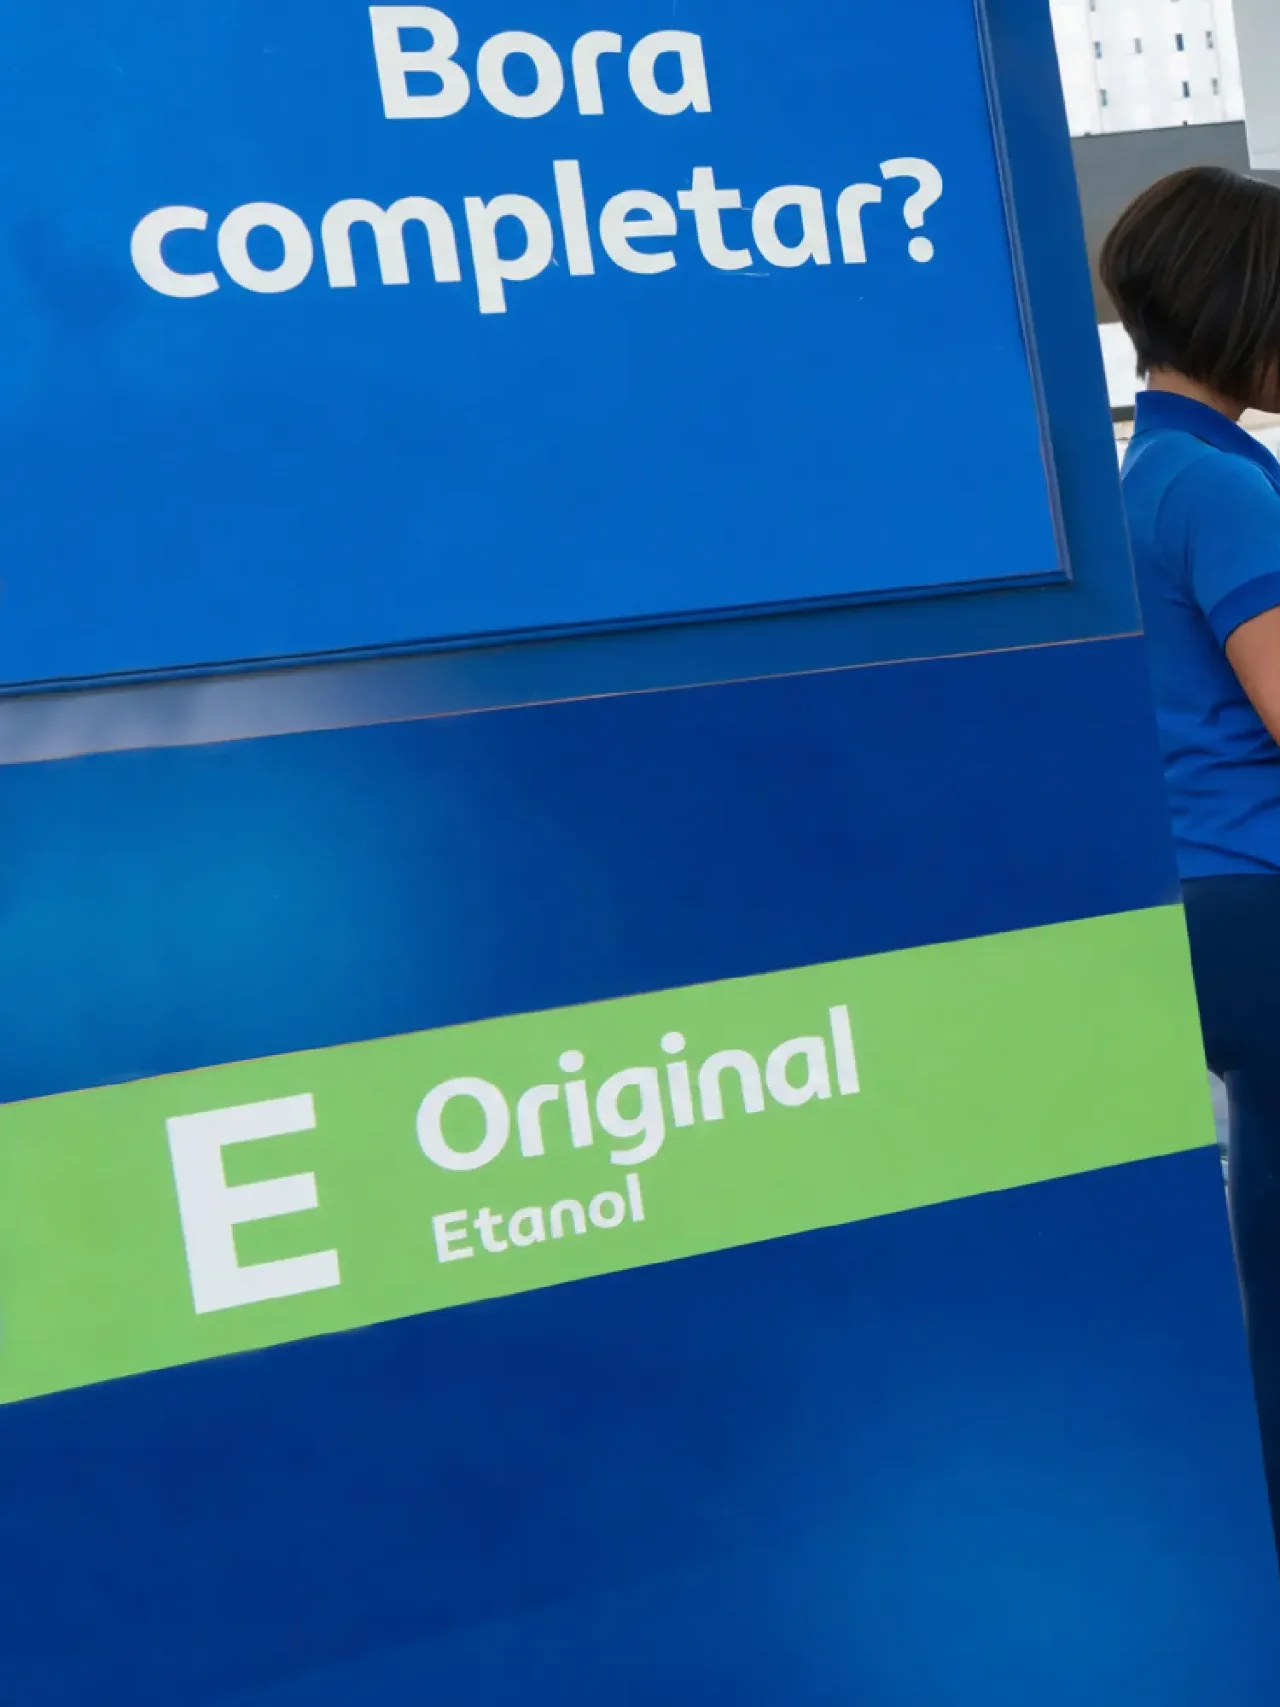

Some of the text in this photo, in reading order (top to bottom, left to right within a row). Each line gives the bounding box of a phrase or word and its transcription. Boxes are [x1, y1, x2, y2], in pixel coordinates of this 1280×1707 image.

[368, 5, 712, 120] Bora
[129, 156, 943, 314] completar?
[415, 1004, 861, 1172] Original
[165, 1092, 341, 1315] E
[430, 1172, 646, 1264] Etanol
